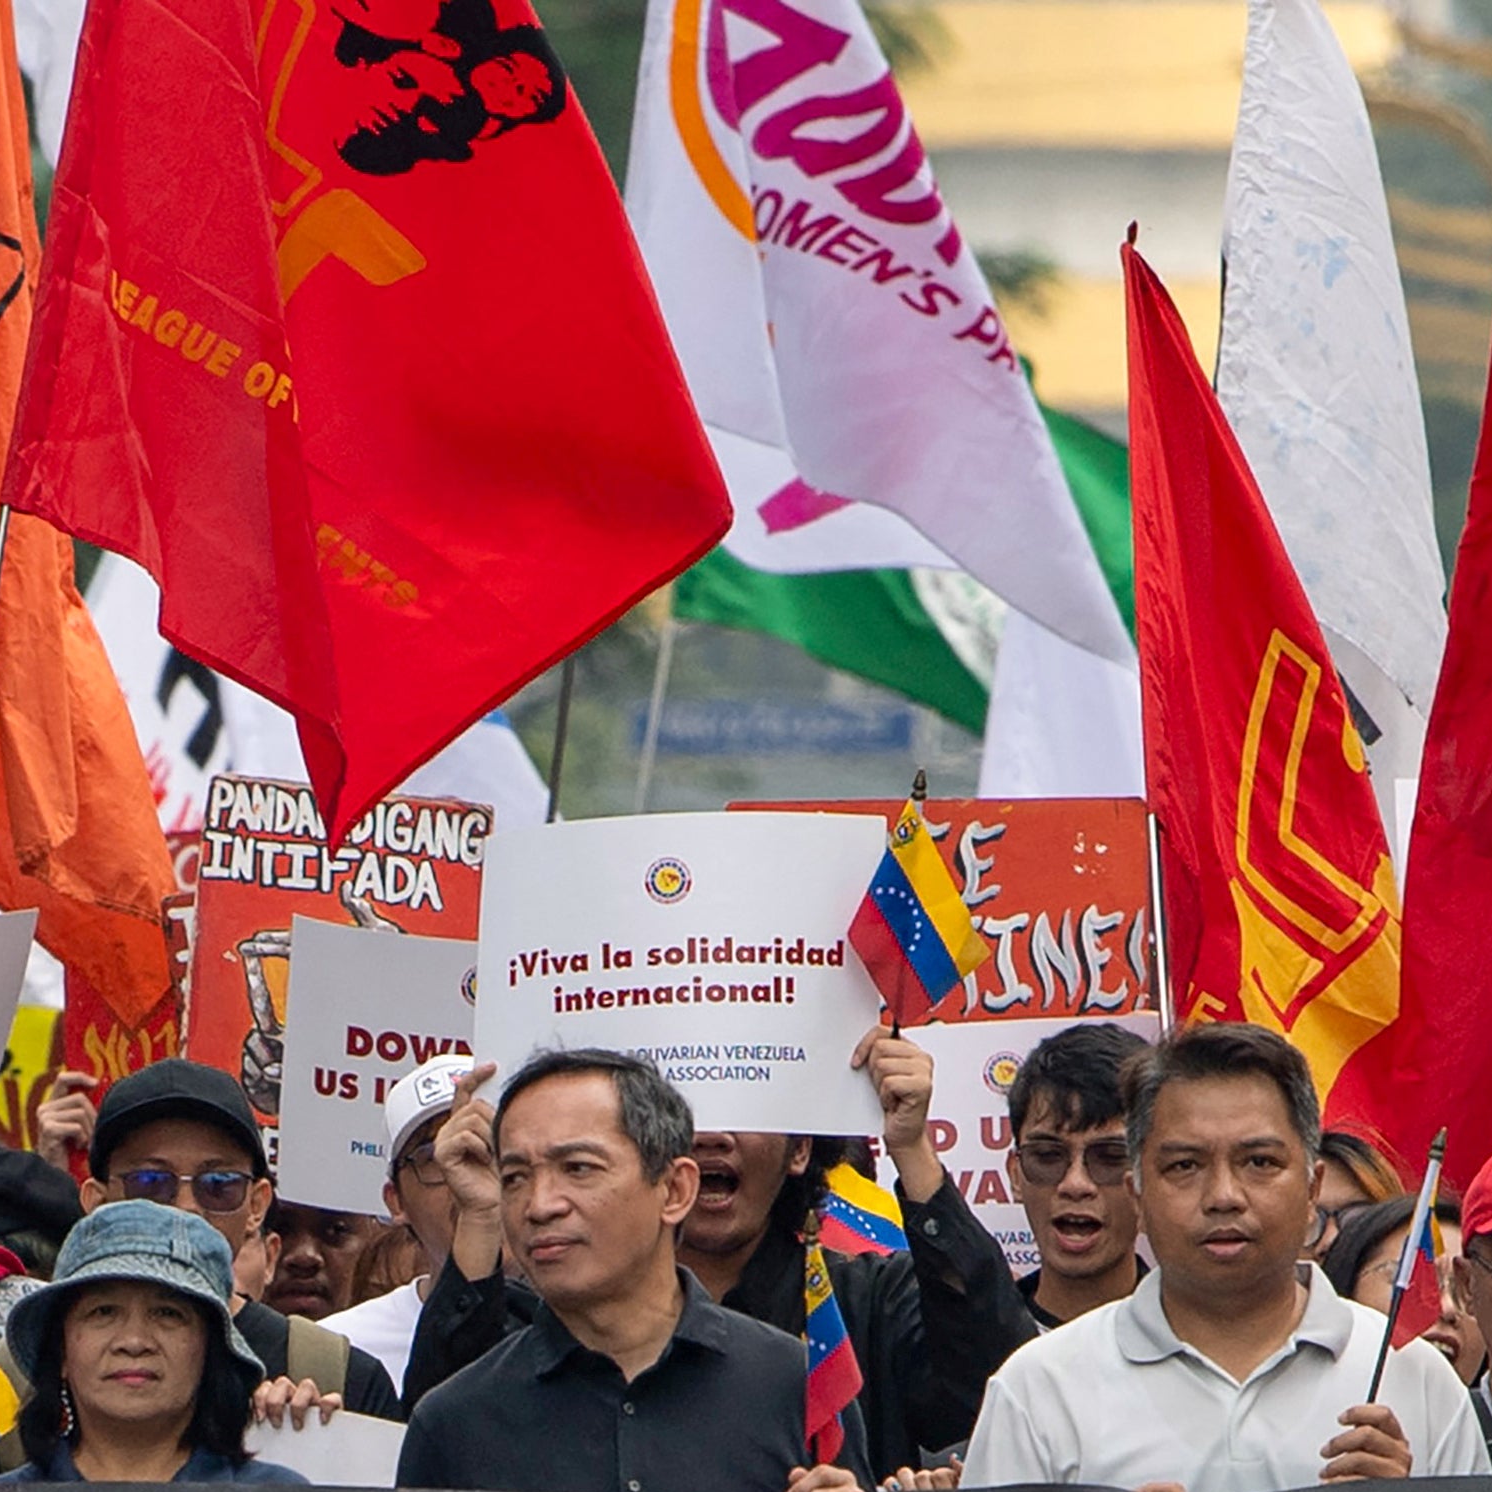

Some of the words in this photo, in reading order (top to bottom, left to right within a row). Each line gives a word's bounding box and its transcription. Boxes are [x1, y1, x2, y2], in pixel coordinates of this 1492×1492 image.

[752, 186, 963, 317] OMEN'S
[201, 831, 444, 912] INTIFADA
[509, 949, 589, 987] ¡Viva
[602, 942, 633, 970] la
[647, 937, 845, 968] solidaridad
[554, 976, 795, 1014] internacional!
[726, 1046, 807, 1062] VENEZUELA
[314, 1066, 359, 1101] US
[665, 1066, 771, 1082] ASSOCIATION
